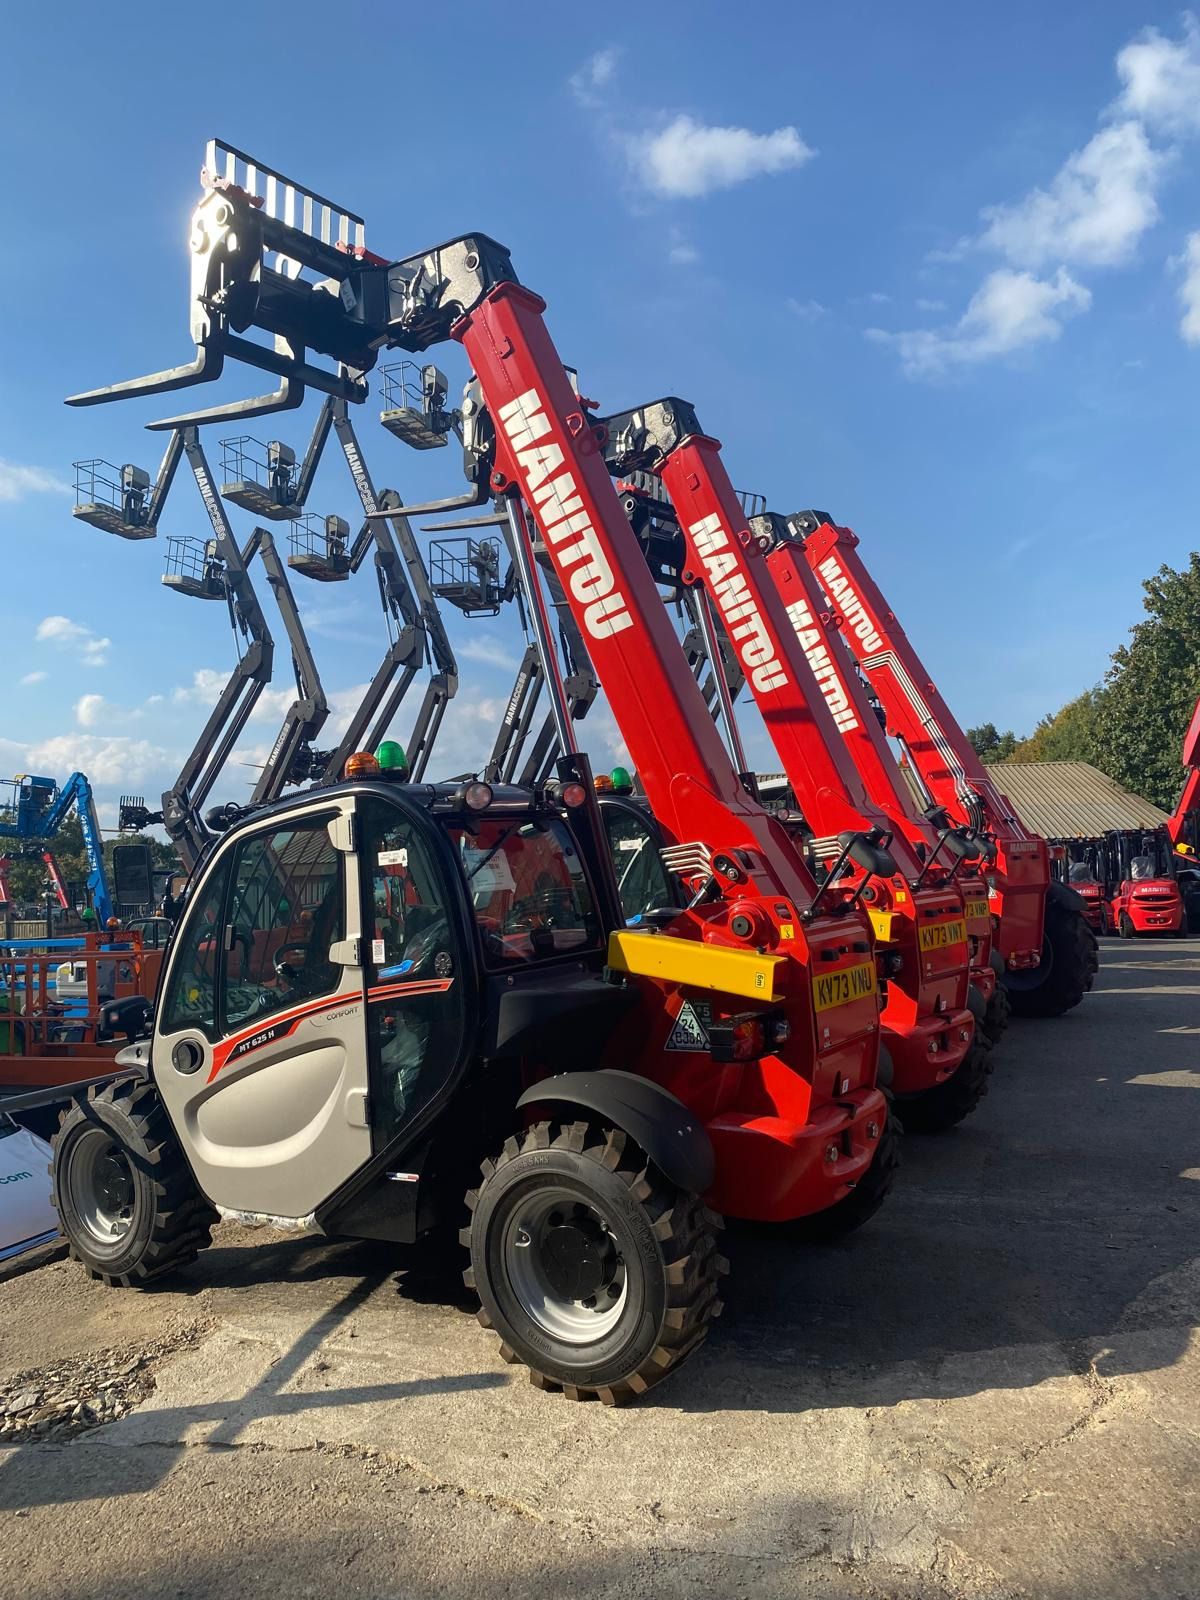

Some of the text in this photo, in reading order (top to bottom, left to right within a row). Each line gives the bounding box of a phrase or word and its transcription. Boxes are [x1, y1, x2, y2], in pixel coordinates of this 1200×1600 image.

[498, 388, 634, 640] MANITOU
[688, 512, 789, 694] MANITOU
[818, 556, 884, 653] MANITOU
[785, 599, 859, 734] MANITOU
[239, 1029, 275, 1053] MT 625 H
[326, 1006, 359, 1021] COMFORT
[681, 1018, 695, 1031] 24
